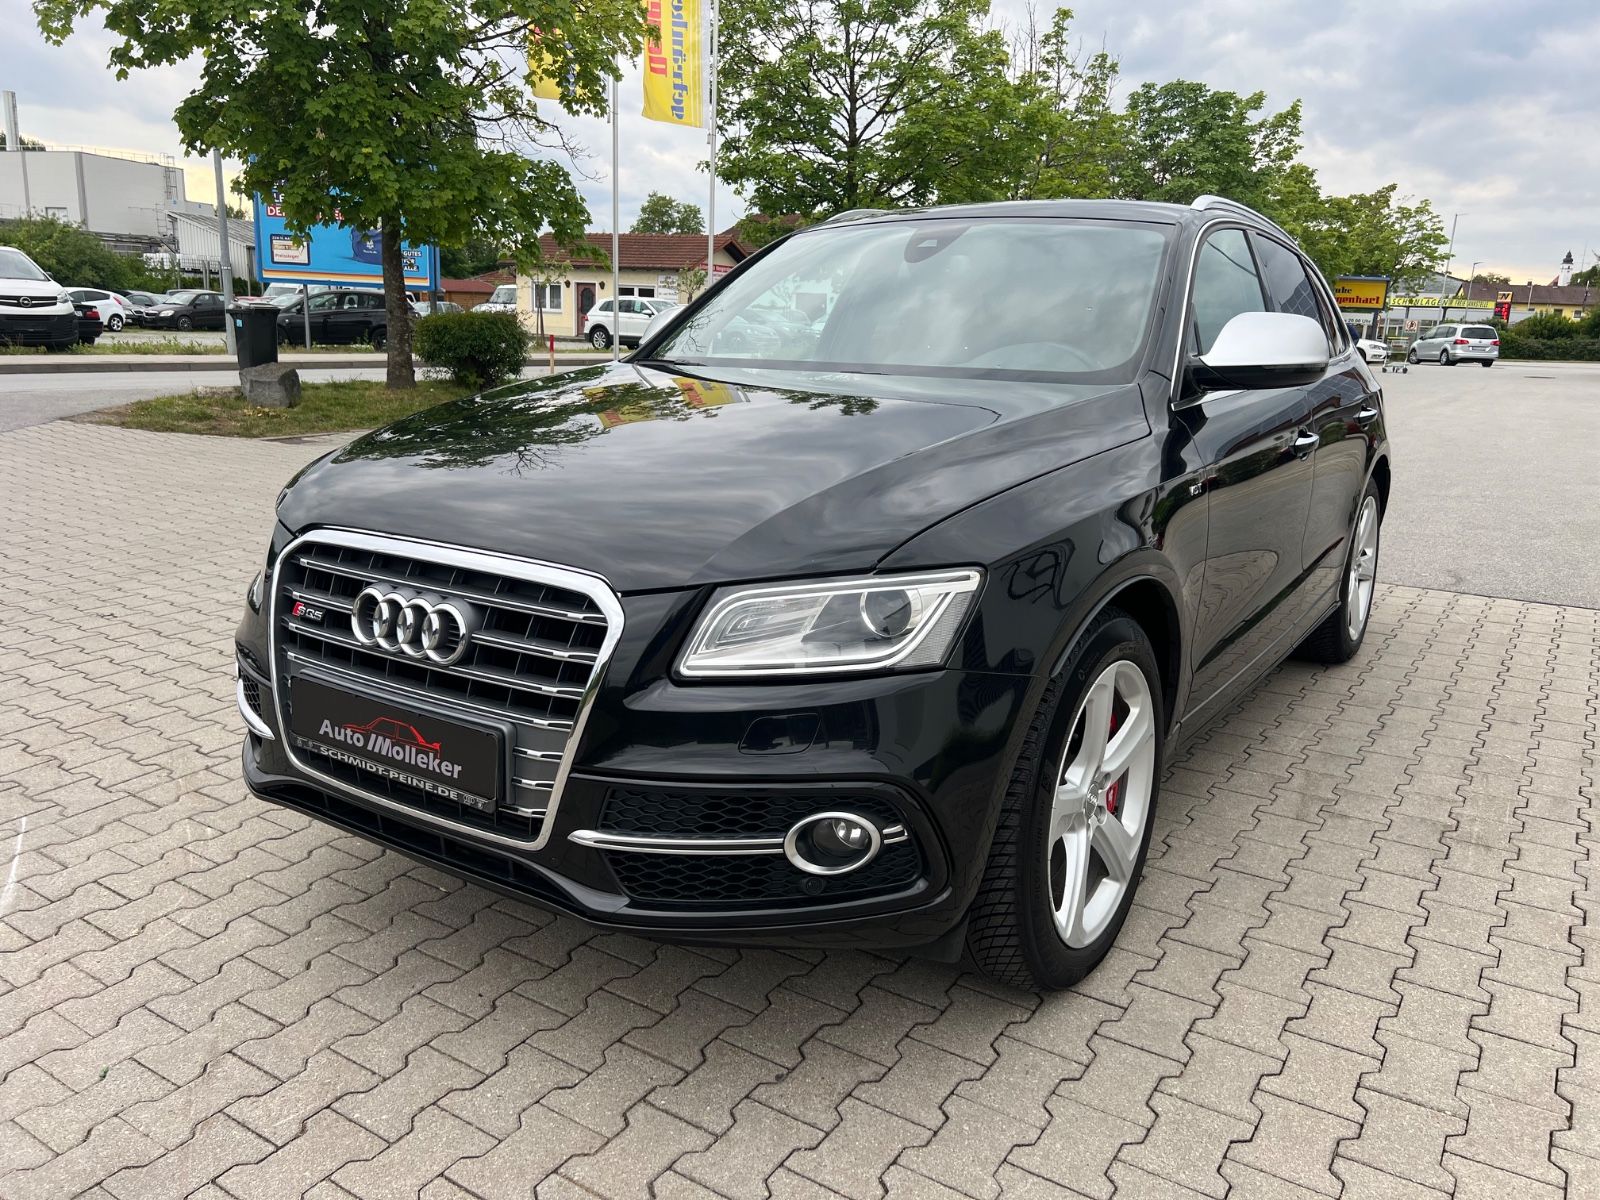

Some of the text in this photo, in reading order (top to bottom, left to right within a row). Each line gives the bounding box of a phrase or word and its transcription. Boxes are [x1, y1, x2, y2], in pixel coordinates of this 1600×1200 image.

[1391, 298, 1449, 306] SCHNLAGEN
[319, 719, 365, 747] Auto
[319, 746, 458, 801] SCHMIDT-PEINE.DE
